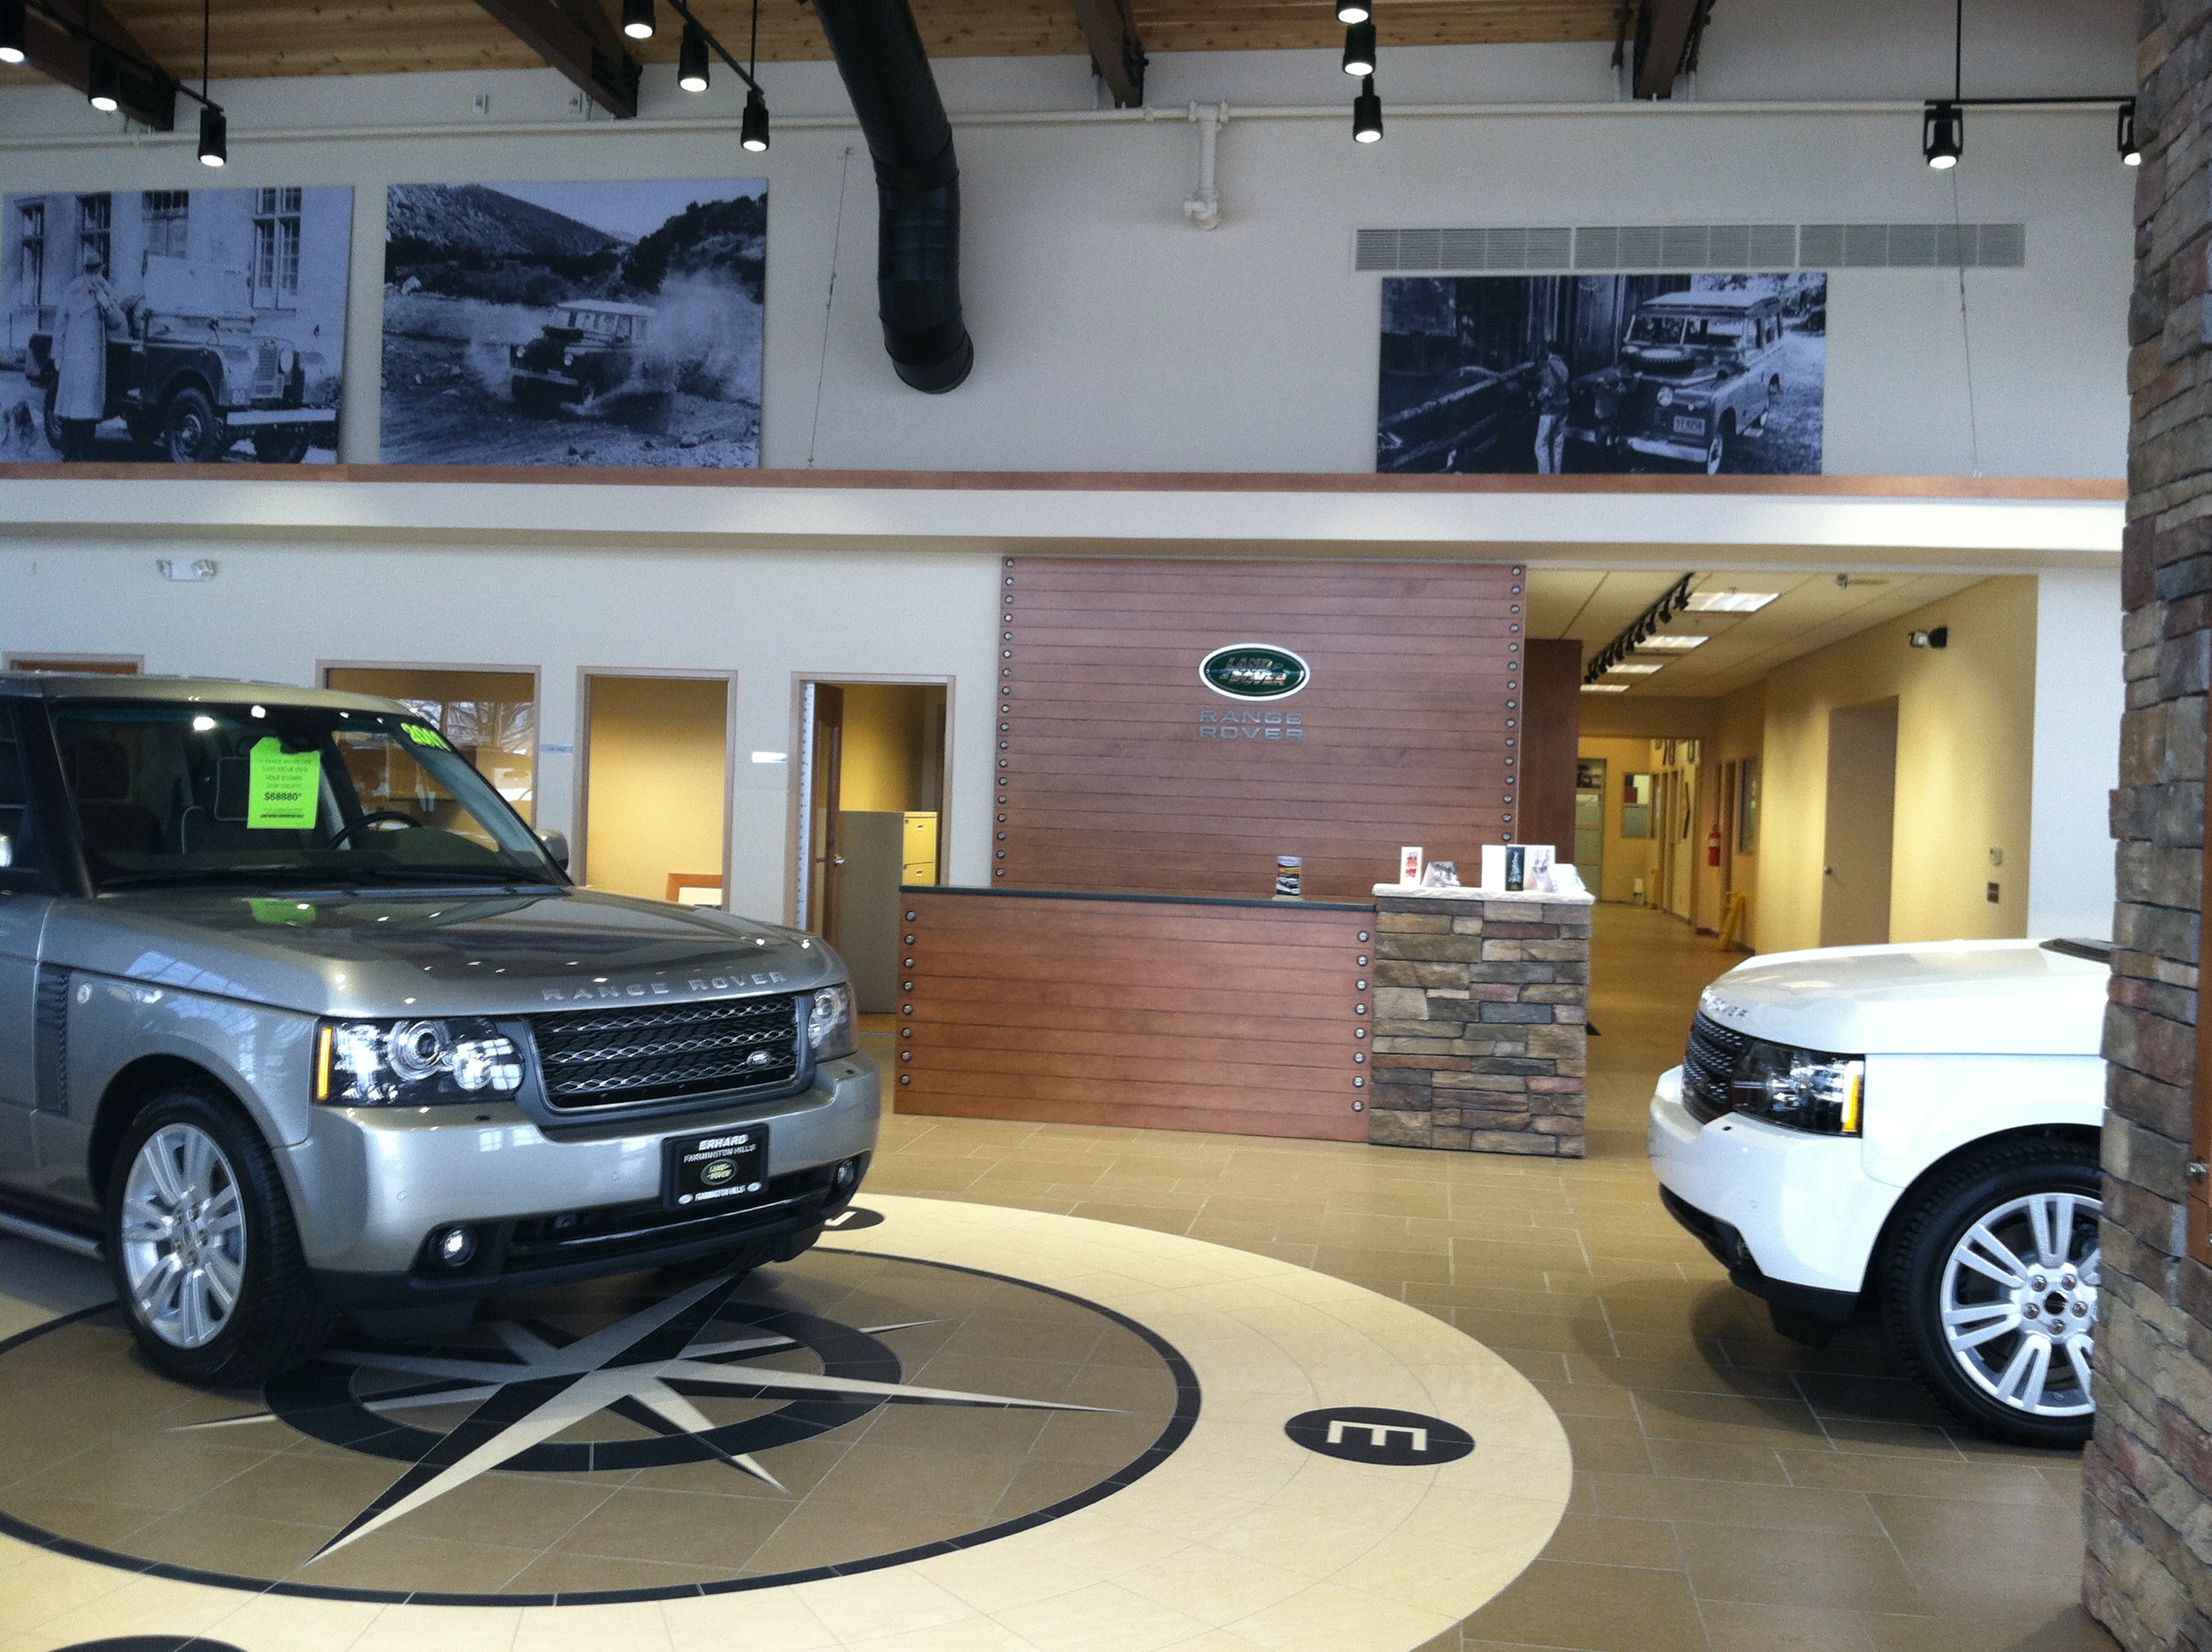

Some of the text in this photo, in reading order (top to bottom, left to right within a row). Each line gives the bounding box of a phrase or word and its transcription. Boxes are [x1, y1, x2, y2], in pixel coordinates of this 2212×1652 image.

[1199, 710, 1303, 725] RANGE
[1199, 725, 1304, 742] ROVER
[541, 970, 788, 1002] RANGE ROVER
[698, 1134, 749, 1151] ERHARD
[684, 1143, 757, 1163] FARMINGTON HILLS
[1326, 1420, 1428, 1451] E
